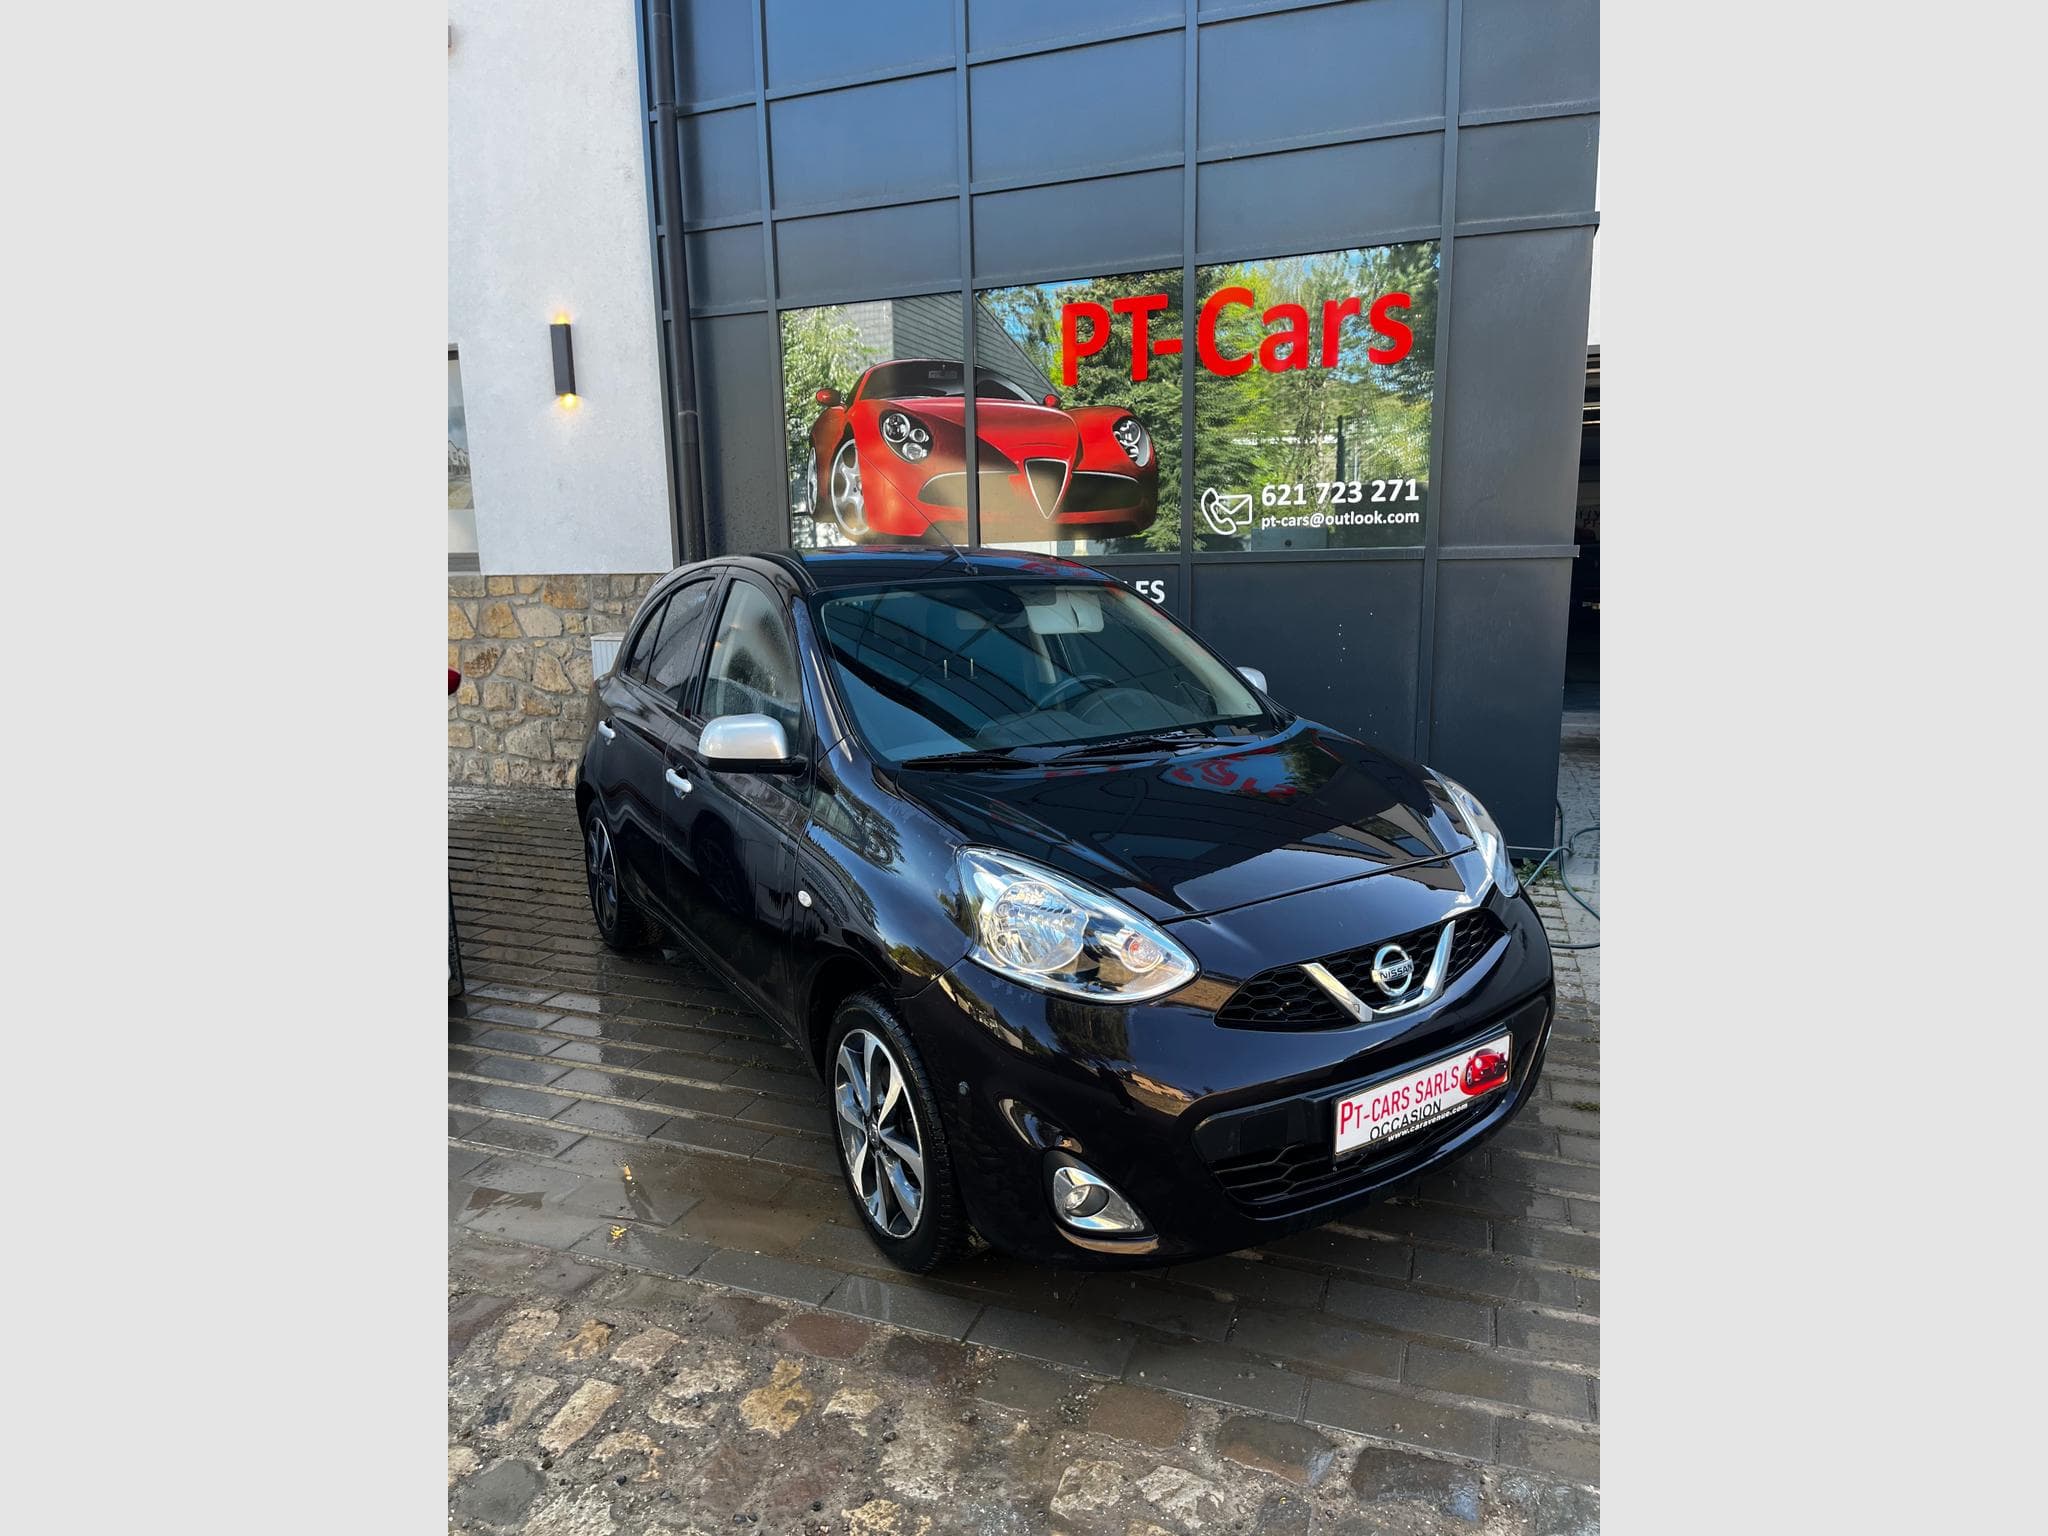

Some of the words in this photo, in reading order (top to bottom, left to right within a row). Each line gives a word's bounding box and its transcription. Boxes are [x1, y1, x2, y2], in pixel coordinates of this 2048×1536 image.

[1061, 286, 1414, 387] PT-Cars
[1261, 483, 1307, 507] 621
[1315, 480, 1363, 505] 723
[1370, 477, 1420, 503] 271
[1261, 510, 1420, 531] pt-cars@outlook.com
[1380, 963, 1413, 980] NISSAN
[1414, 1065, 1460, 1104] SARLS
[1369, 1098, 1442, 1141] OCCASION
[1387, 1103, 1468, 1142] www.caravenue.com
